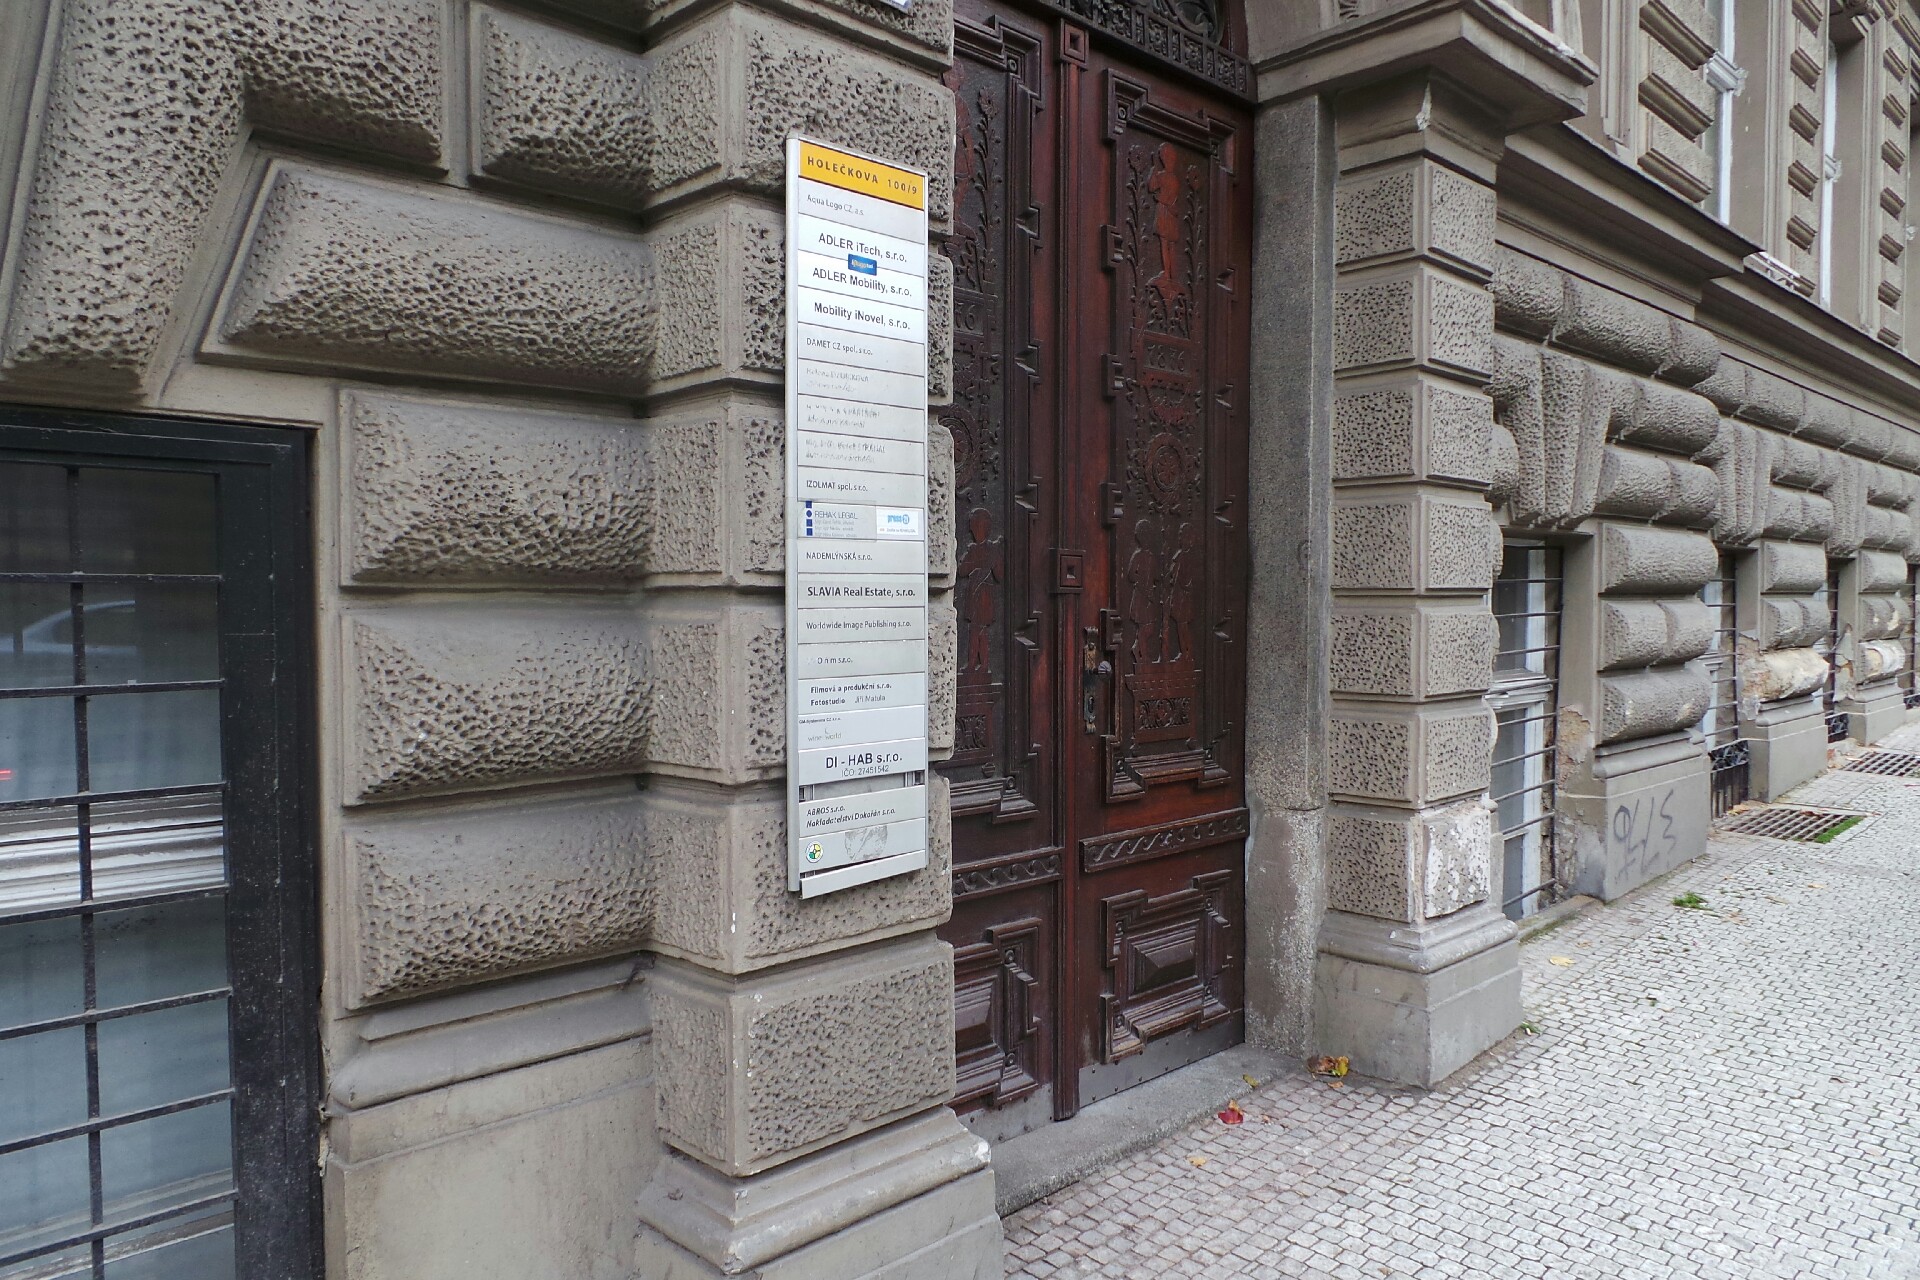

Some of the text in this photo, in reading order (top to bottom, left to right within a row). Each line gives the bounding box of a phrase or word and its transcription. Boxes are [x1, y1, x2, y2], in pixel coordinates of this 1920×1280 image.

[807, 155, 918, 195] HOLEČKOVA 100/9
[807, 194, 825, 206] Aqua
[818, 232, 907, 263] ADLER iTech, s.r.o.
[812, 267, 912, 297] ADLER Mobility, s.r.o.
[814, 302, 911, 330] Mobility iNovel, s.r.o.
[806, 337, 831, 349] DAMET
[832, 341, 841, 351] CZ
[806, 480, 836, 490] IZOLMAT
[807, 586, 916, 599] SLAVIA Real Estate, s.r.o.
[806, 619, 912, 631] Worldwide Image Publishing s.r.o.
[810, 686, 836, 694] Filmová
[843, 683, 875, 693] produkční
[810, 698, 846, 707] Fotostudio
[826, 756, 838, 769] DI
[848, 752, 873, 766] HAB
[876, 752, 902, 763] s.r.o.
[857, 764, 890, 776] 27451542
[807, 805, 846, 816] ABROS s.r.o.
[806, 813, 854, 828] Nakladatelství
